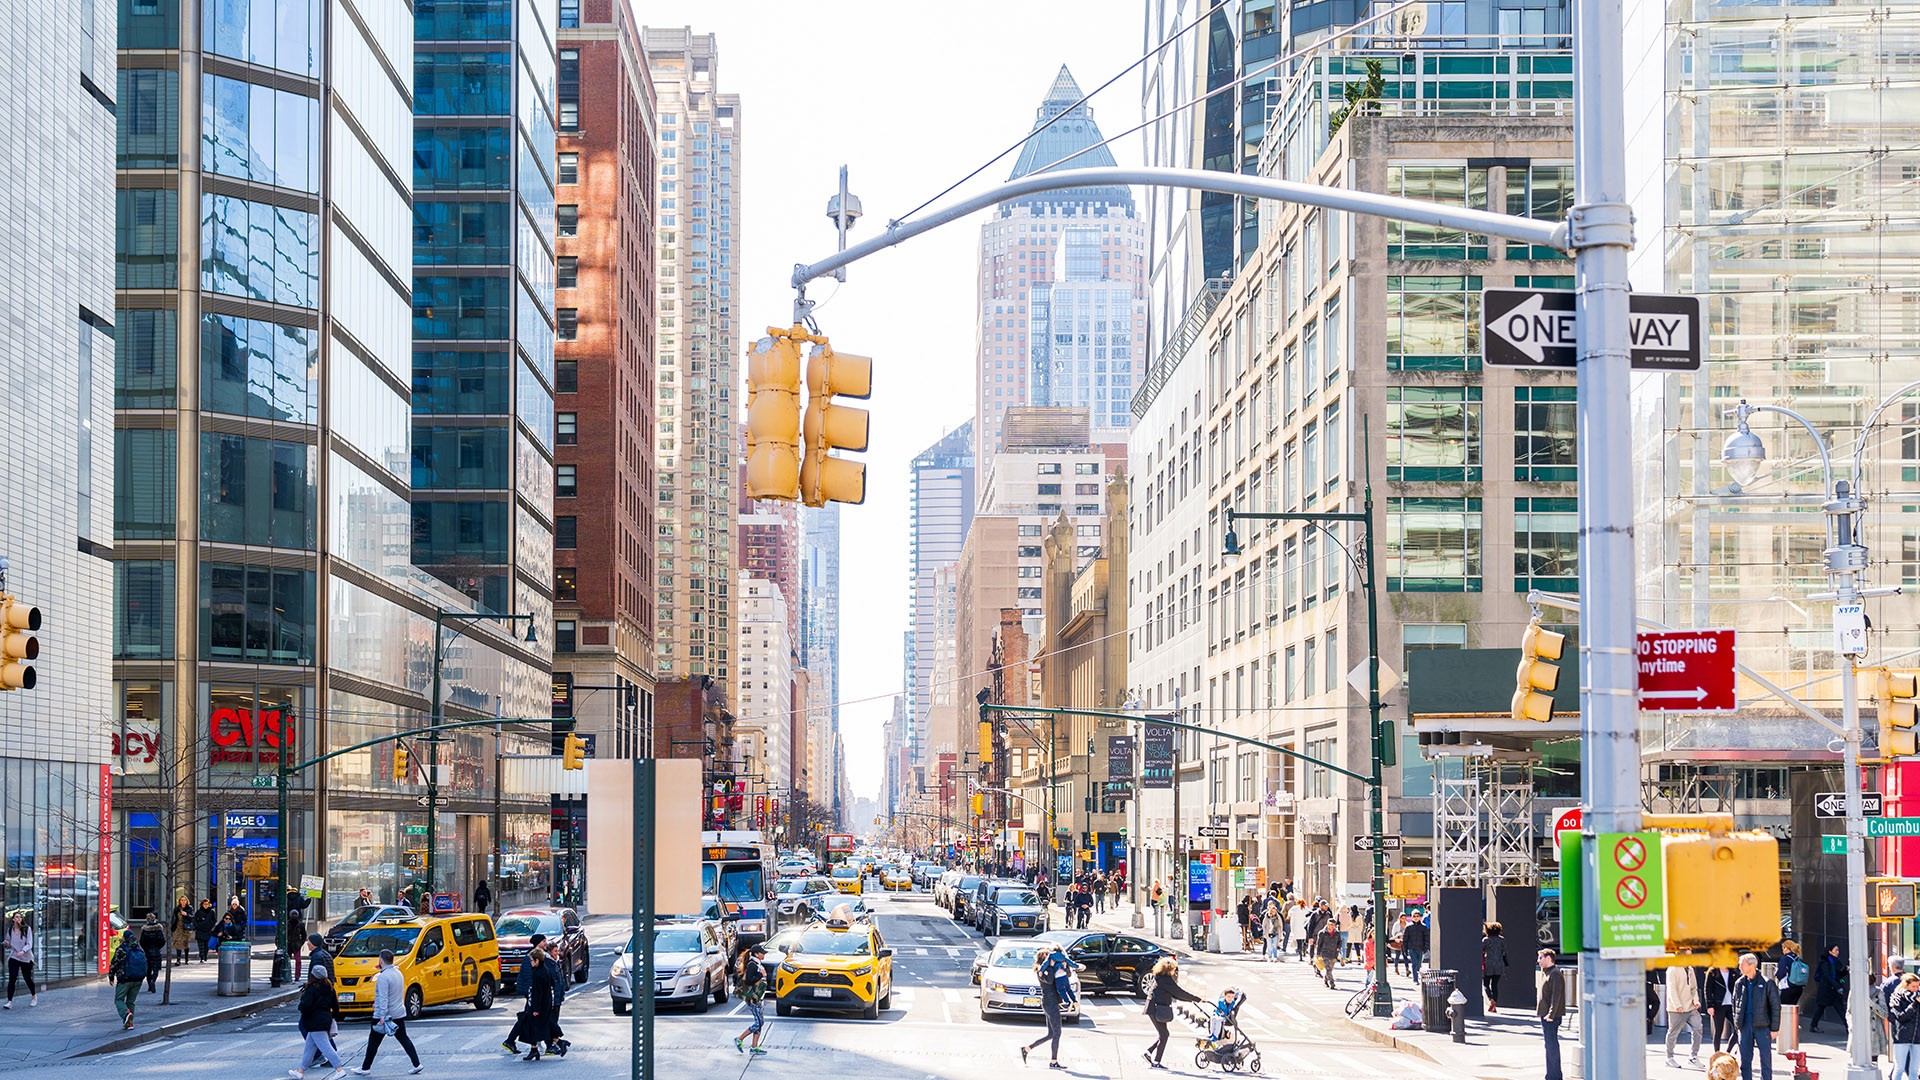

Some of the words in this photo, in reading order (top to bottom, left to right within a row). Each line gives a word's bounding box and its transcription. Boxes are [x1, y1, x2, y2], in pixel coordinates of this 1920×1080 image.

[1508, 314, 1576, 343] ONE
[1653, 638, 1717, 655] STOPPING
[1637, 658, 1686, 676] nytime
[210, 707, 295, 748] CVS
[1145, 728, 1172, 736] VOLTA
[1109, 747, 1132, 755] VOLTA
[1145, 743, 1166, 751] NEW
[1823, 801, 1845, 810] ONE
[1862, 800, 1876, 809] AY
[226, 816, 255, 825] HASE
[1563, 818, 1577, 827] DO
[103, 838, 109, 852] of
[1830, 837, 1836, 852] 8
[1614, 913, 1661, 922] skateboarding
[1619, 923, 1634, 931] bike
[1635, 923, 1655, 932] riding
